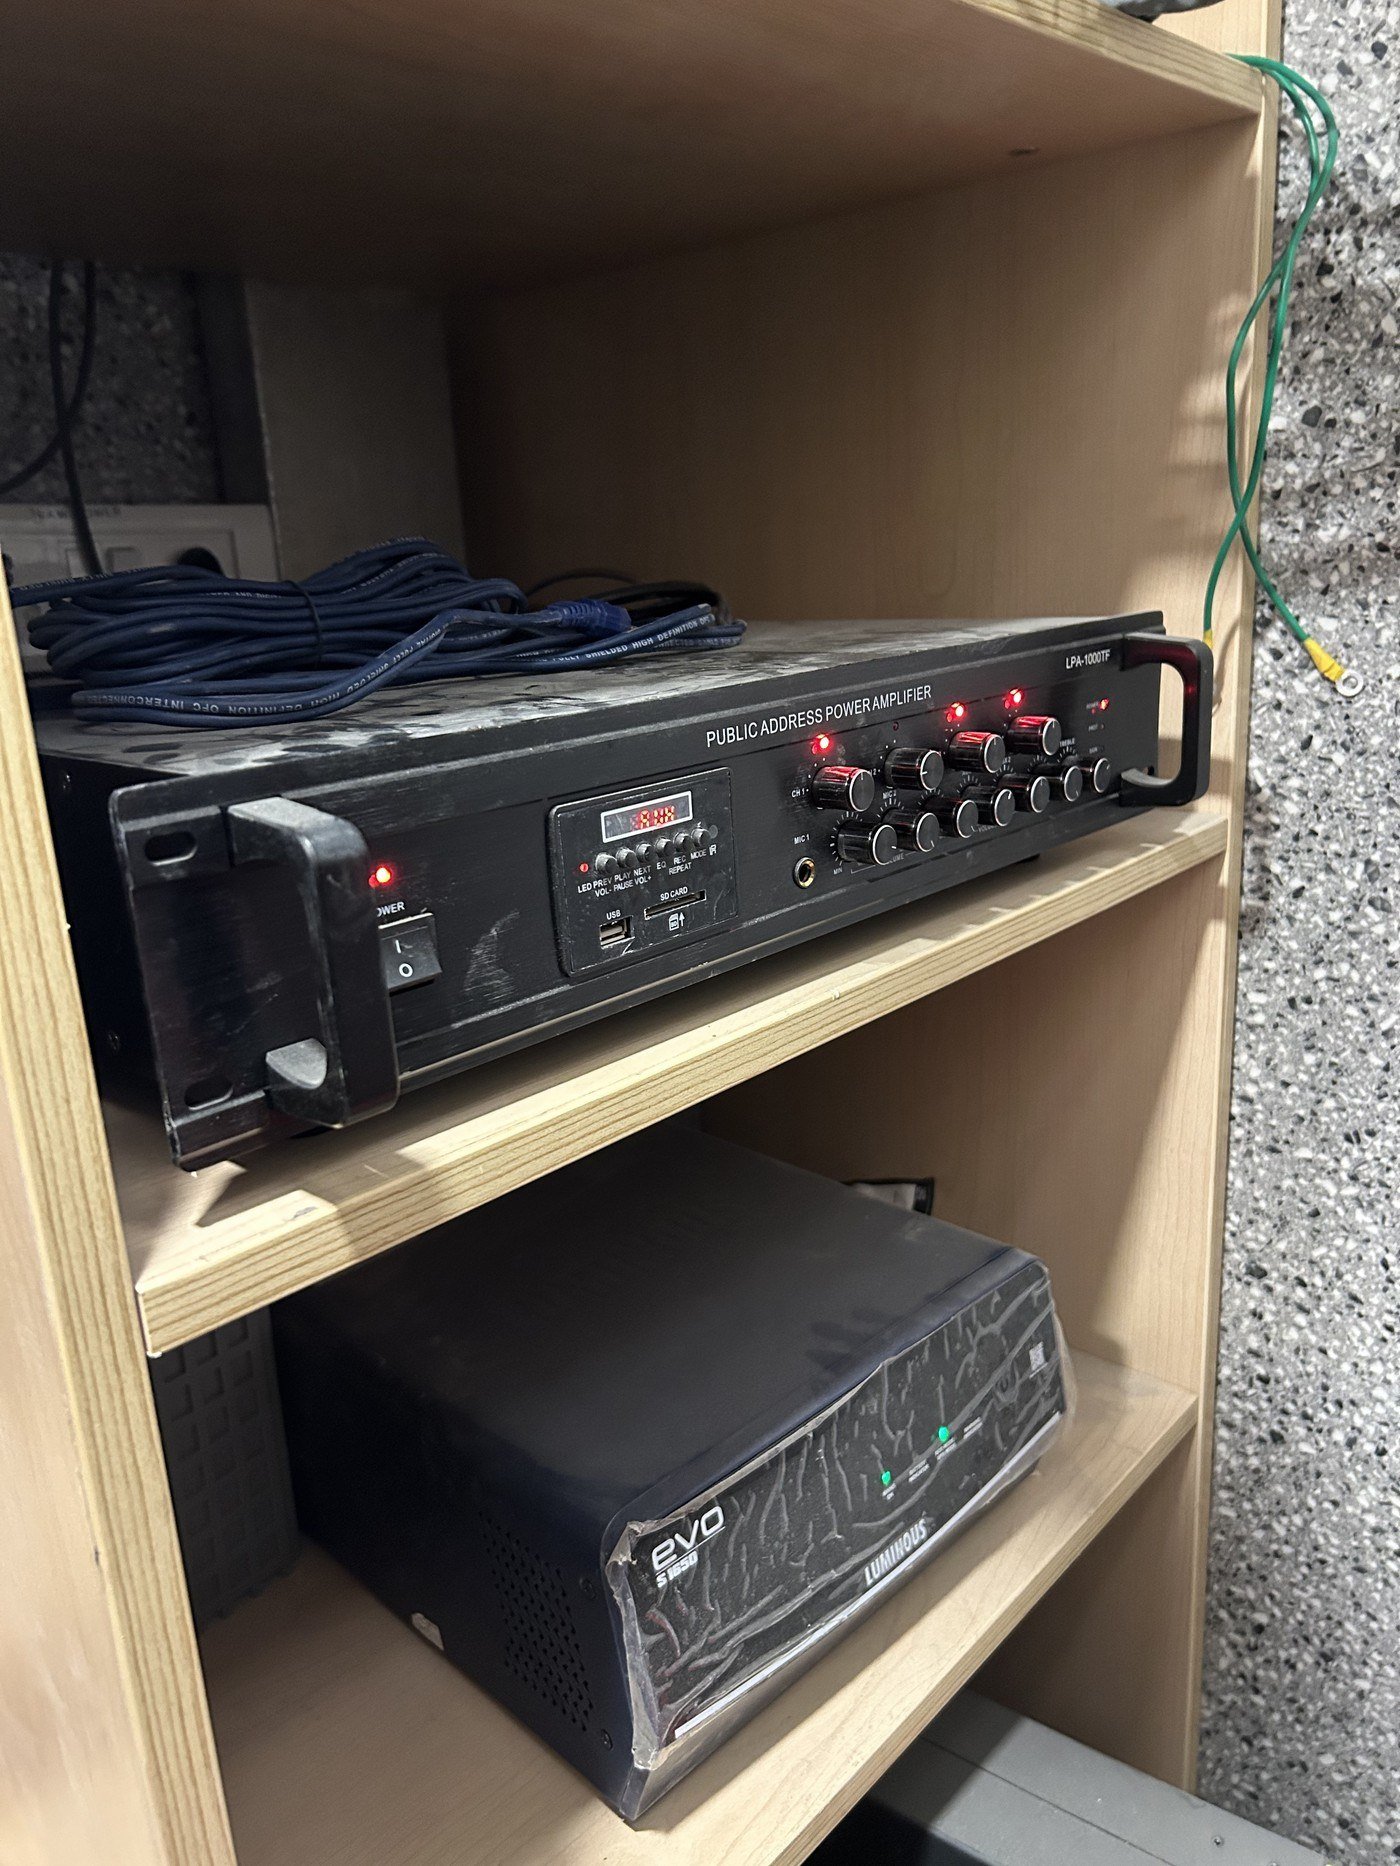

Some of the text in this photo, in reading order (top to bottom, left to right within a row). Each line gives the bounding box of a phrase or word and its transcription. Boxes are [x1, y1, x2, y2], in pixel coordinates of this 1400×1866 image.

[632, 637, 654, 650] HIGH
[656, 620, 700, 642] DEFINITION
[1065, 649, 1111, 669] LPA-1000TF
[192, 702, 219, 713] OFC
[706, 685, 932, 747] PUBLIC ADDRESS POWER AMPLIFIER
[792, 787, 806, 798] CH 1
[882, 790, 892, 800] MIC
[794, 836, 804, 845] MIC
[578, 882, 592, 893] LED
[592, 876, 612, 888] PREV
[614, 870, 632, 882] PLAY
[634, 866, 651, 876] NEXT
[656, 862, 666, 870] EQ
[674, 854, 686, 865] REC
[690, 848, 706, 860] MODE
[614, 881, 634, 892] PAUSE
[668, 862, 692, 875] REPEAT
[660, 886, 688, 902] SD CARD
[376, 901, 405, 917] OWER
[606, 910, 622, 920] USB
[652, 1506, 724, 1571] evo
[864, 1518, 928, 1586] LUMINOUS
